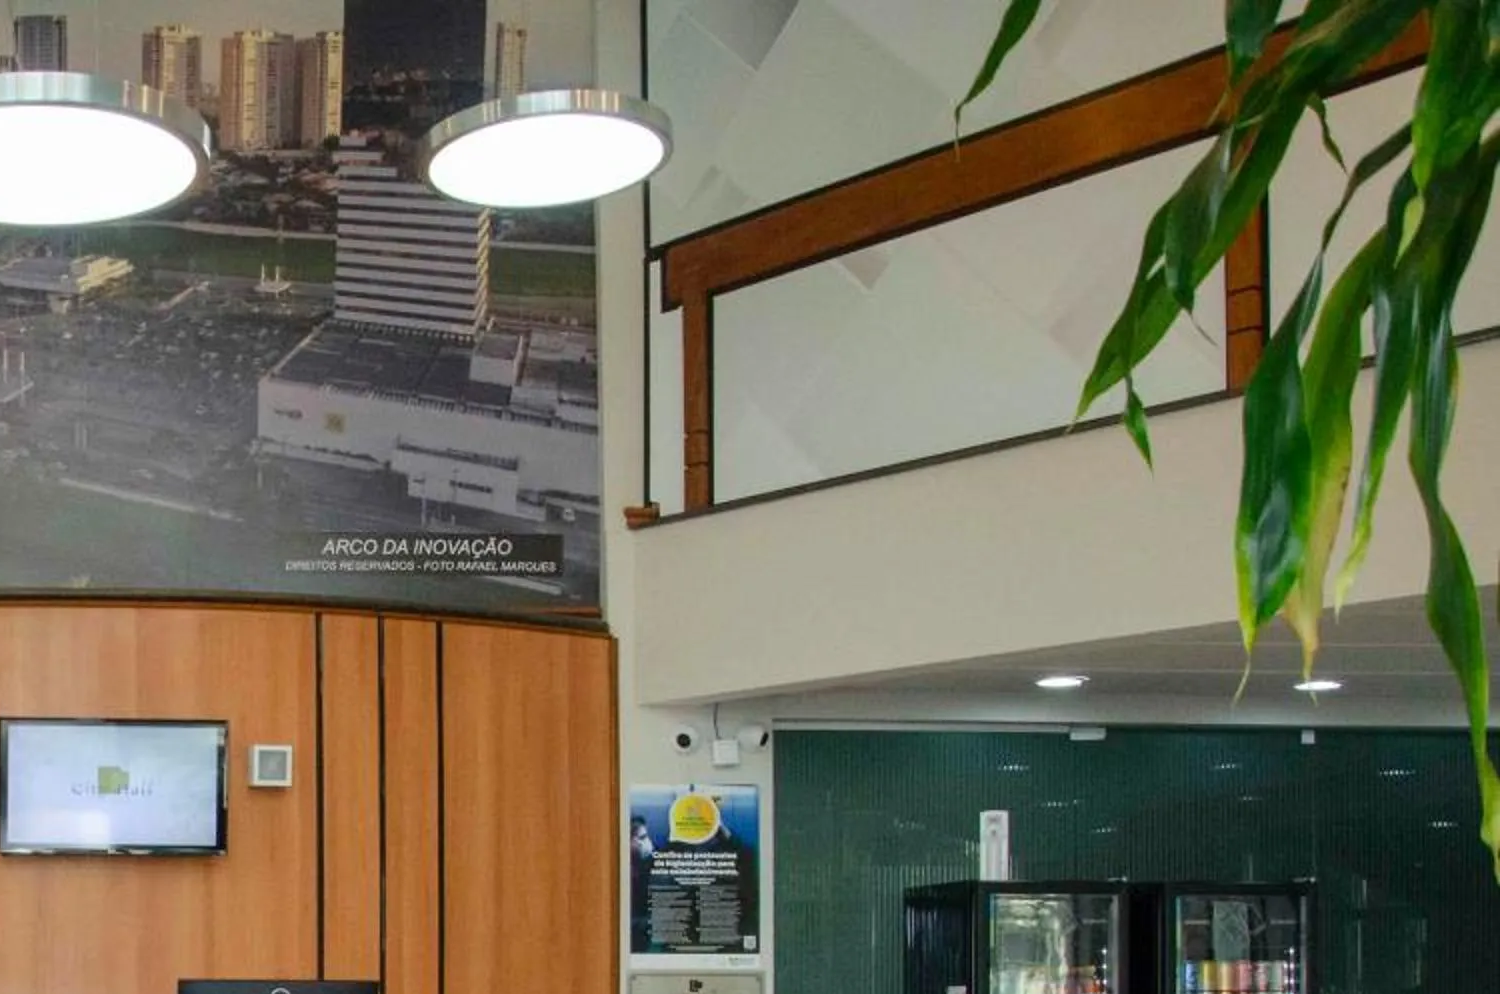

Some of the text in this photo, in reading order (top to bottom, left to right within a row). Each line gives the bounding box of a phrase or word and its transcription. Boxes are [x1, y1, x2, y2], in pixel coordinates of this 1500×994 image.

[321, 537, 513, 560] ARCO DA INOVAÇÃO
[285, 560, 338, 572] DIREITOS
[339, 560, 415, 572] RESERVADOS
[423, 560, 454, 572] FOTO
[456, 560, 499, 572] RAFAEL
[500, 560, 557, 573] MARQUES
